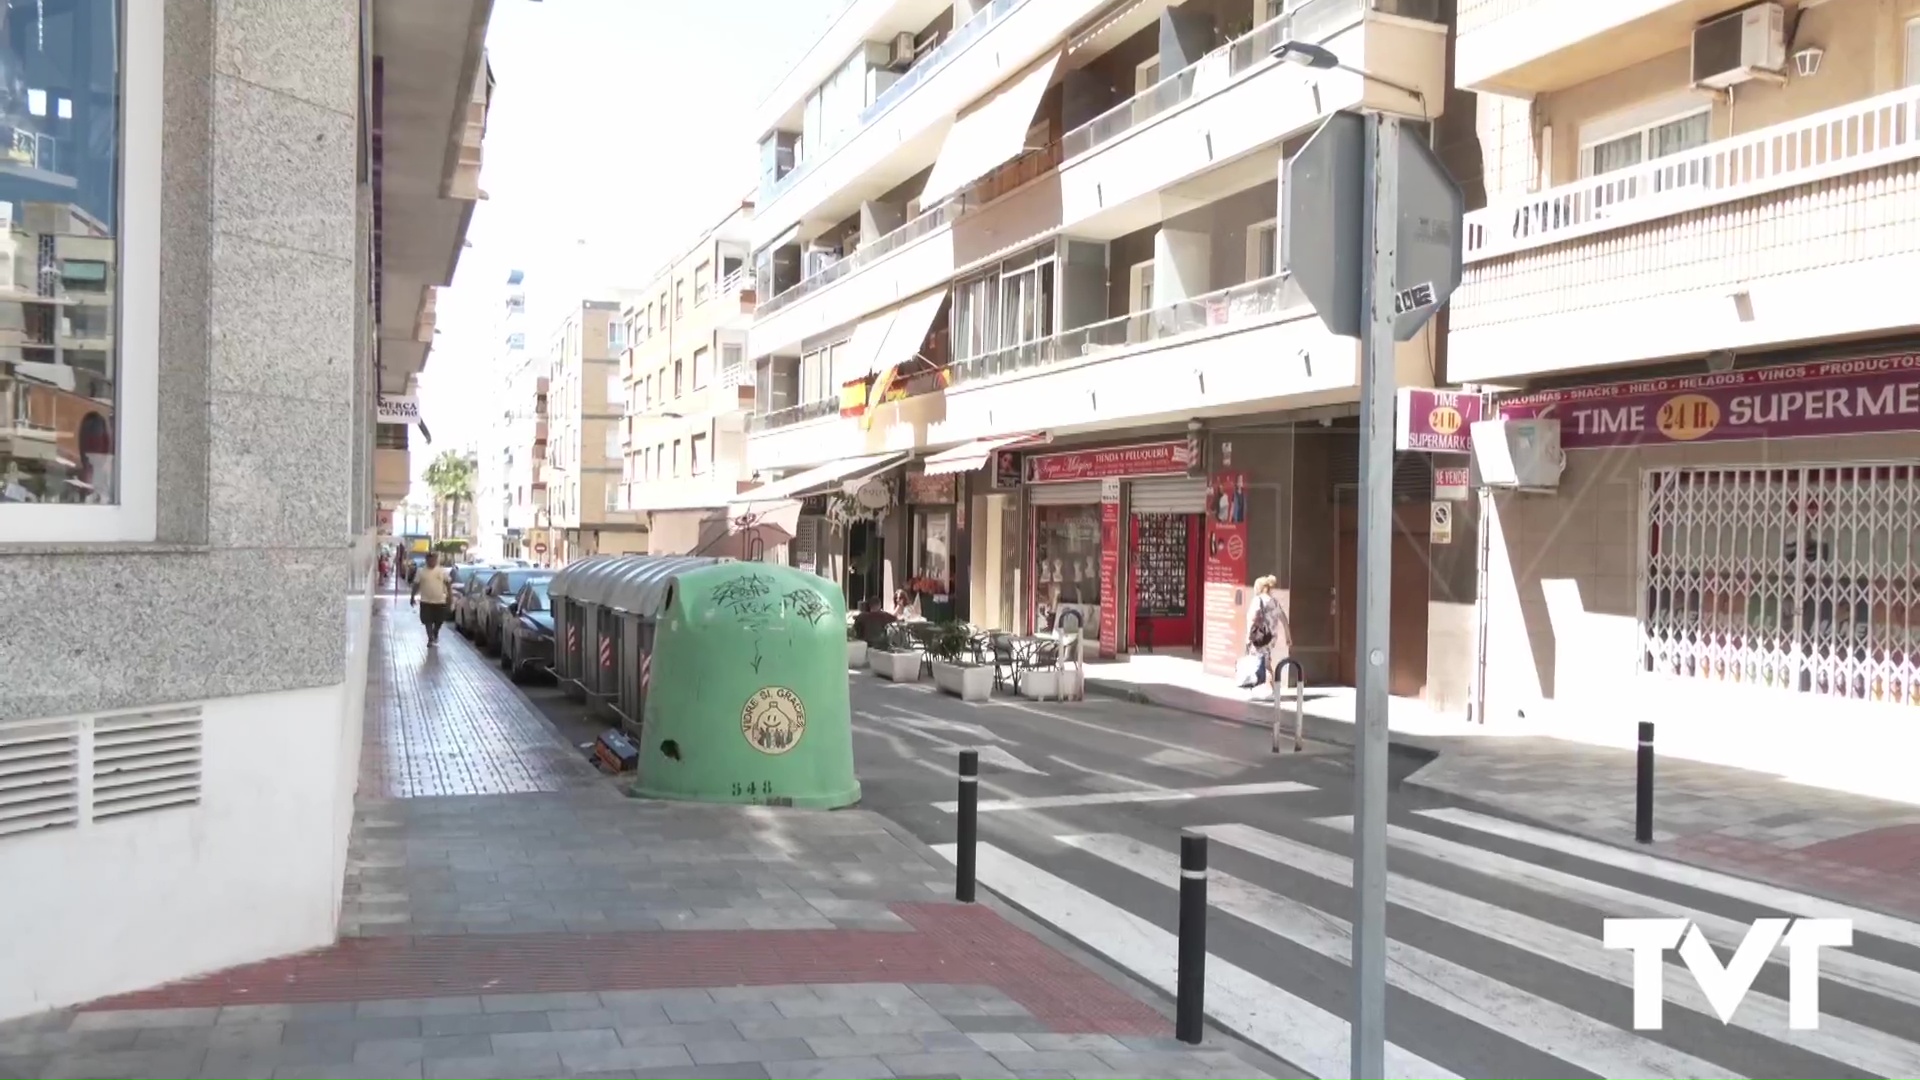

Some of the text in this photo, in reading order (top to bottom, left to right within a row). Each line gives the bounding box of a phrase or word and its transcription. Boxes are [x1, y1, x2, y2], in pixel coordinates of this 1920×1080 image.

[1570, 387, 1619, 399] SNACKS
[1629, 380, 1668, 393] HIELO
[1679, 373, 1745, 389] HELADOS
[1757, 367, 1806, 381] VINOS
[379, 401, 417, 410] MERCA
[1433, 392, 1459, 407] TIME
[379, 409, 418, 417] CENTRO
[1572, 382, 1920, 435] TIME 24 H. SUPERME
[1432, 411, 1445, 428] 24
[1095, 452, 1119, 464] TIENDA
[1120, 452, 1126, 461] Y
[1435, 471, 1468, 485] SE VENDE
